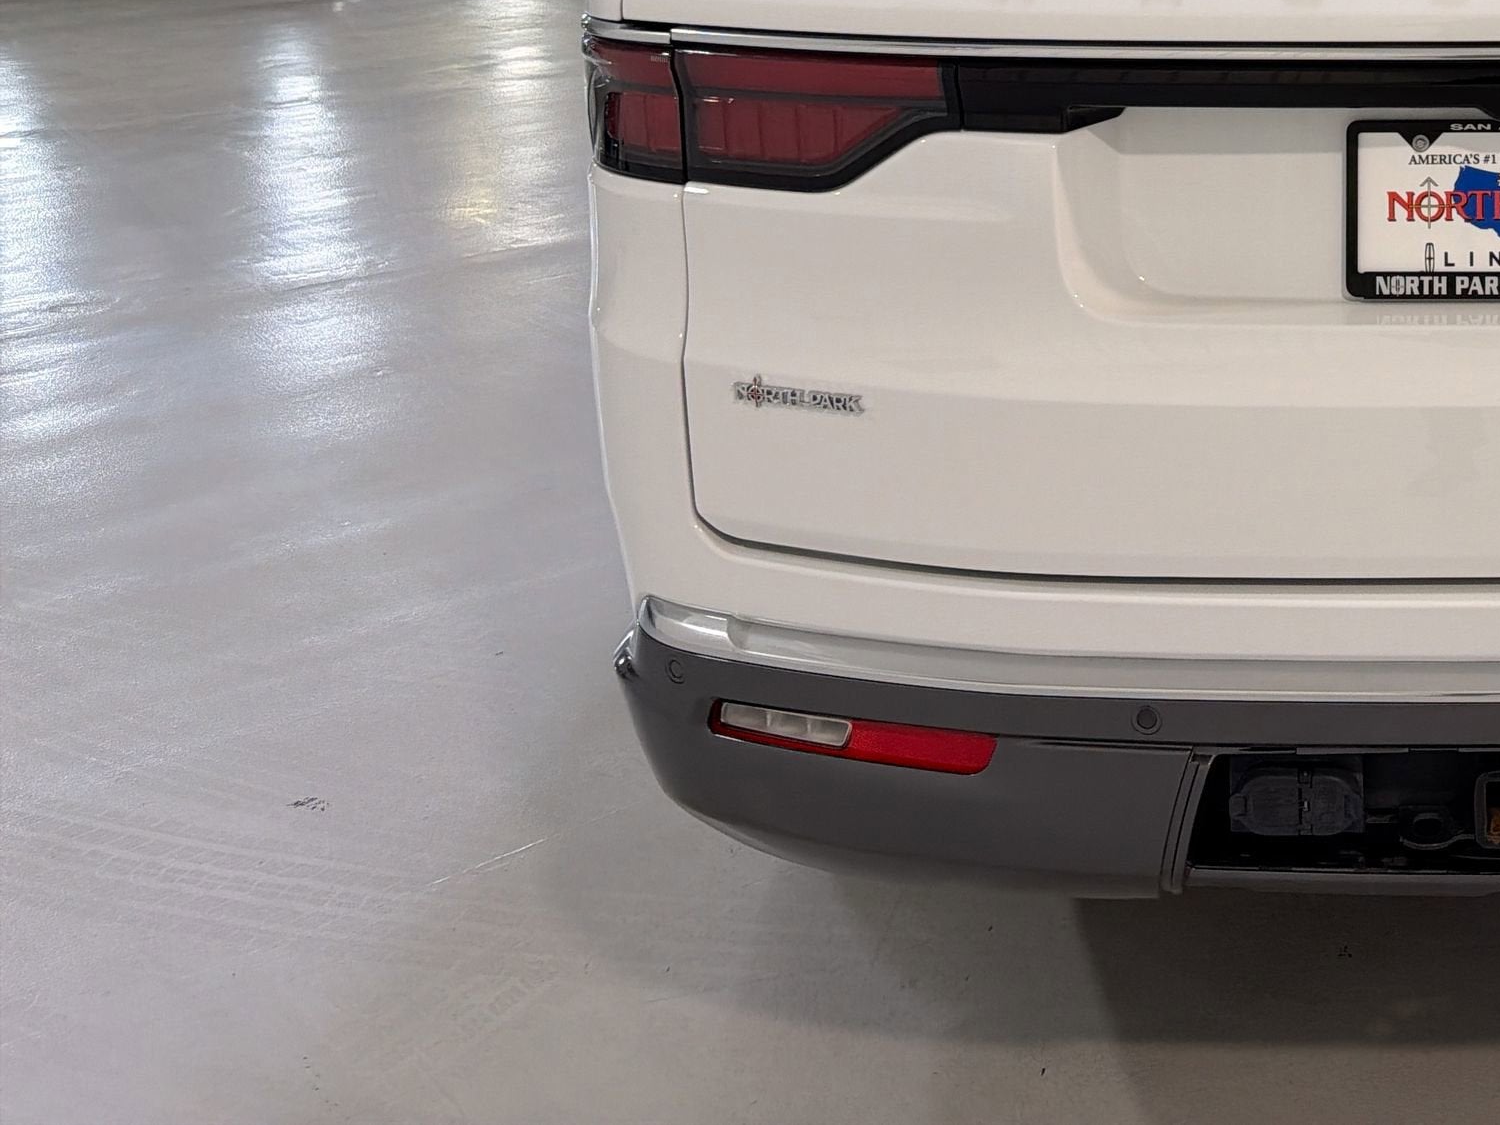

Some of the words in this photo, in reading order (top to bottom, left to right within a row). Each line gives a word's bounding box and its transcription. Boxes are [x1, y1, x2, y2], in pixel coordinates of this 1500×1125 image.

[1450, 122, 1492, 132] SAN
[1408, 153, 1480, 166] AMERICA'S
[1483, 153, 1497, 165] #1
[1375, 275, 1448, 296] NORTH
[733, 380, 804, 406] NORTH
[807, 391, 865, 416] PARK
